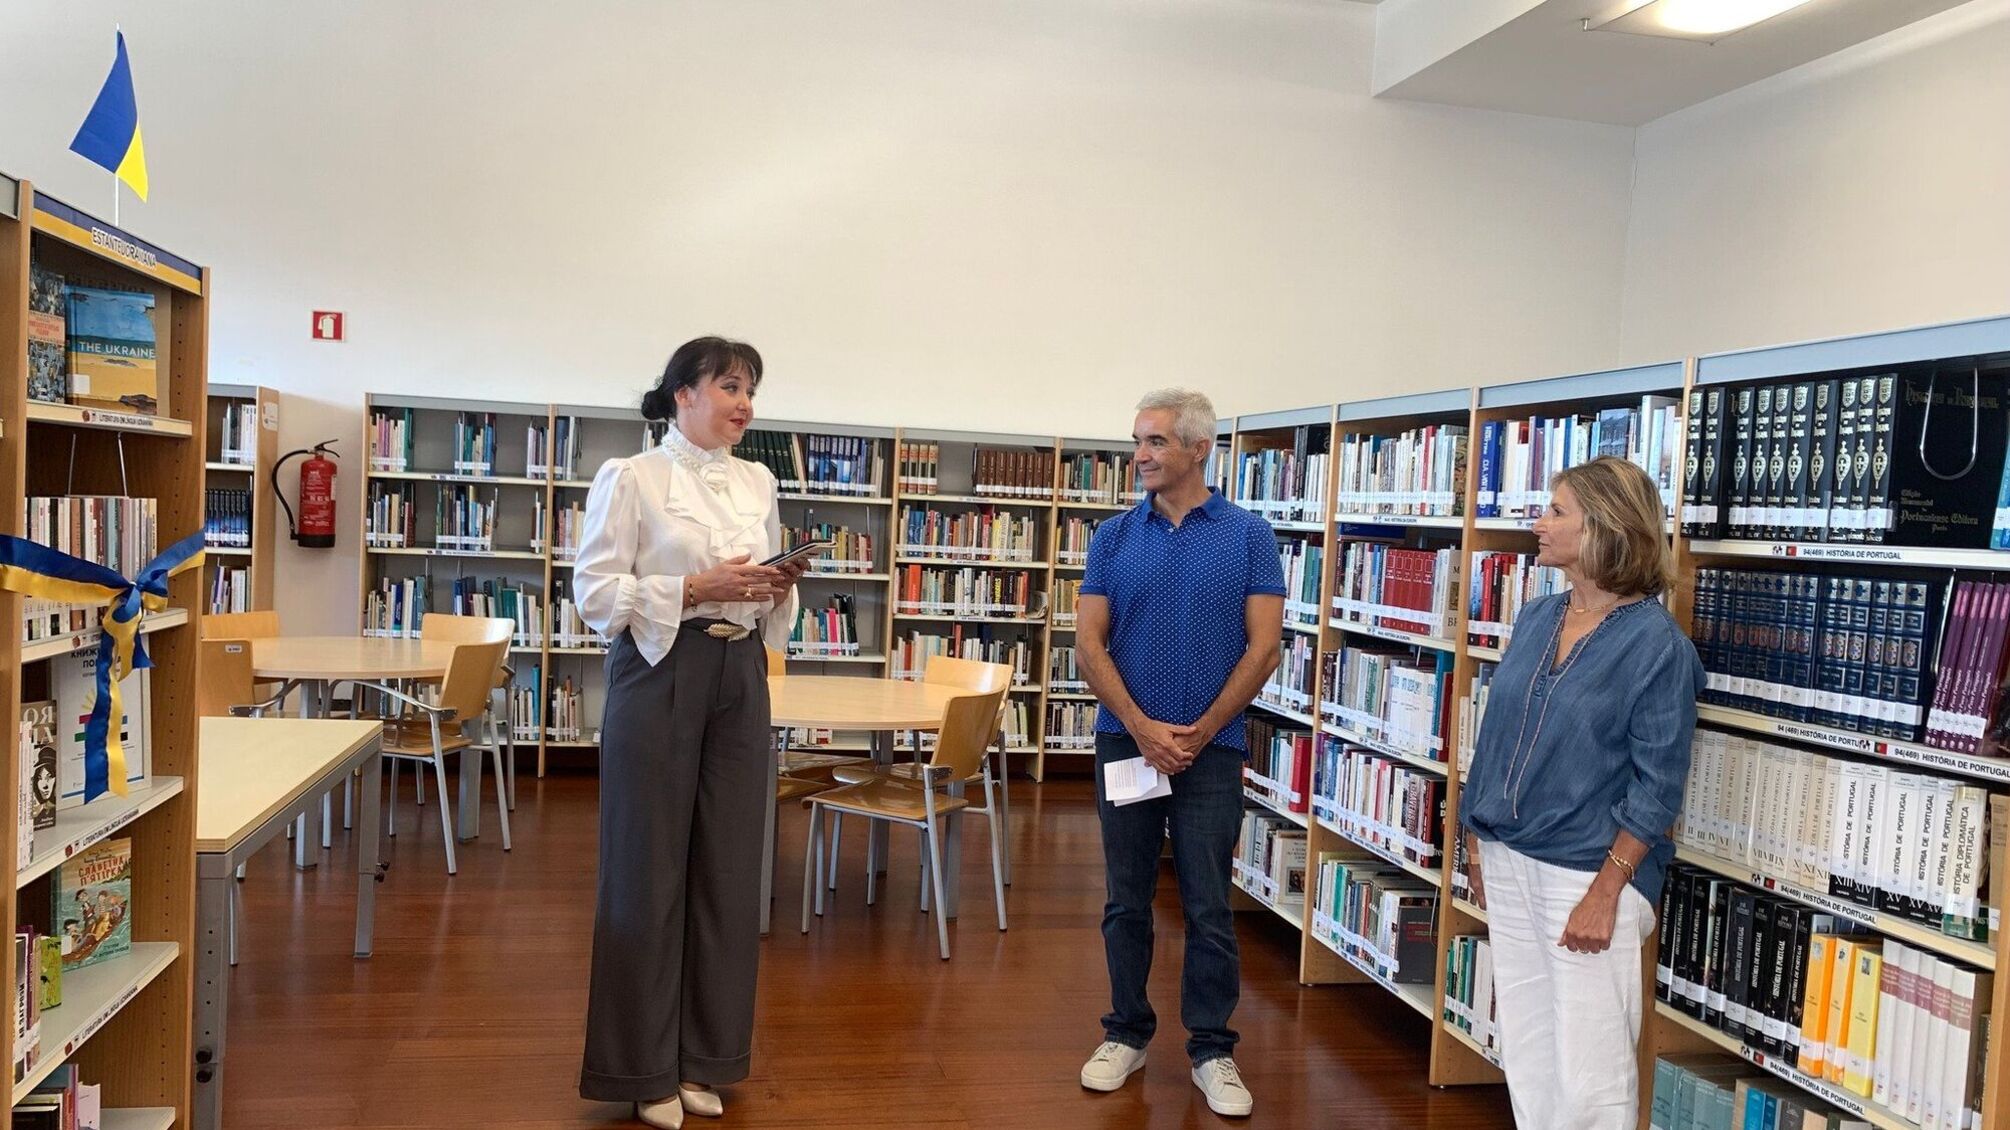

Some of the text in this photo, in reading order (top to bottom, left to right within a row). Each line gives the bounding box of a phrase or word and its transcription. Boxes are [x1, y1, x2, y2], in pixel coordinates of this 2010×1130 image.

[80, 341, 156, 359] THE UKRAINE
[1826, 549, 1855, 558] HISTÓRIA
[1866, 551, 1901, 560] PORTUGAL
[1800, 729, 1827, 740] HISTÓRIA
[1828, 734, 1837, 743] DE
[1838, 736, 1861, 747] PORTU
[1894, 748, 2010, 777] 94(469) HISTÓRIA DE PORTUGAL
[1847, 780, 1857, 817] PORTUGAL
[1868, 782, 1877, 821] PORTUGAL
[1897, 792, 1907, 831] PORTUGAL
[1924, 794, 1934, 833] PORTUGAL
[1943, 800, 1954, 840] PORTUGAL
[1846, 821, 1853, 830] DE
[1866, 824, 1872, 834] DE
[1896, 834, 1903, 844] DE
[1922, 837, 1929, 847] DE
[1941, 842, 1949, 853] DE
[1953, 806, 1969, 895] ISTÓRIA DIPLOMÁTICA
[1964, 825, 1976, 884] DE PORTUGAL
[1835, 875, 1853, 888] XIII
[1854, 882, 1872, 895] XIV
[1803, 892, 1831, 908] HISTÓRIA
[1832, 903, 1841, 912] DE
[1842, 906, 1876, 923] PORTUGAL
[1792, 1071, 1820, 1092] HISTÓRIA
[1821, 1087, 1831, 1098] DE
[1830, 1092, 1865, 1116] PORTUGAL
